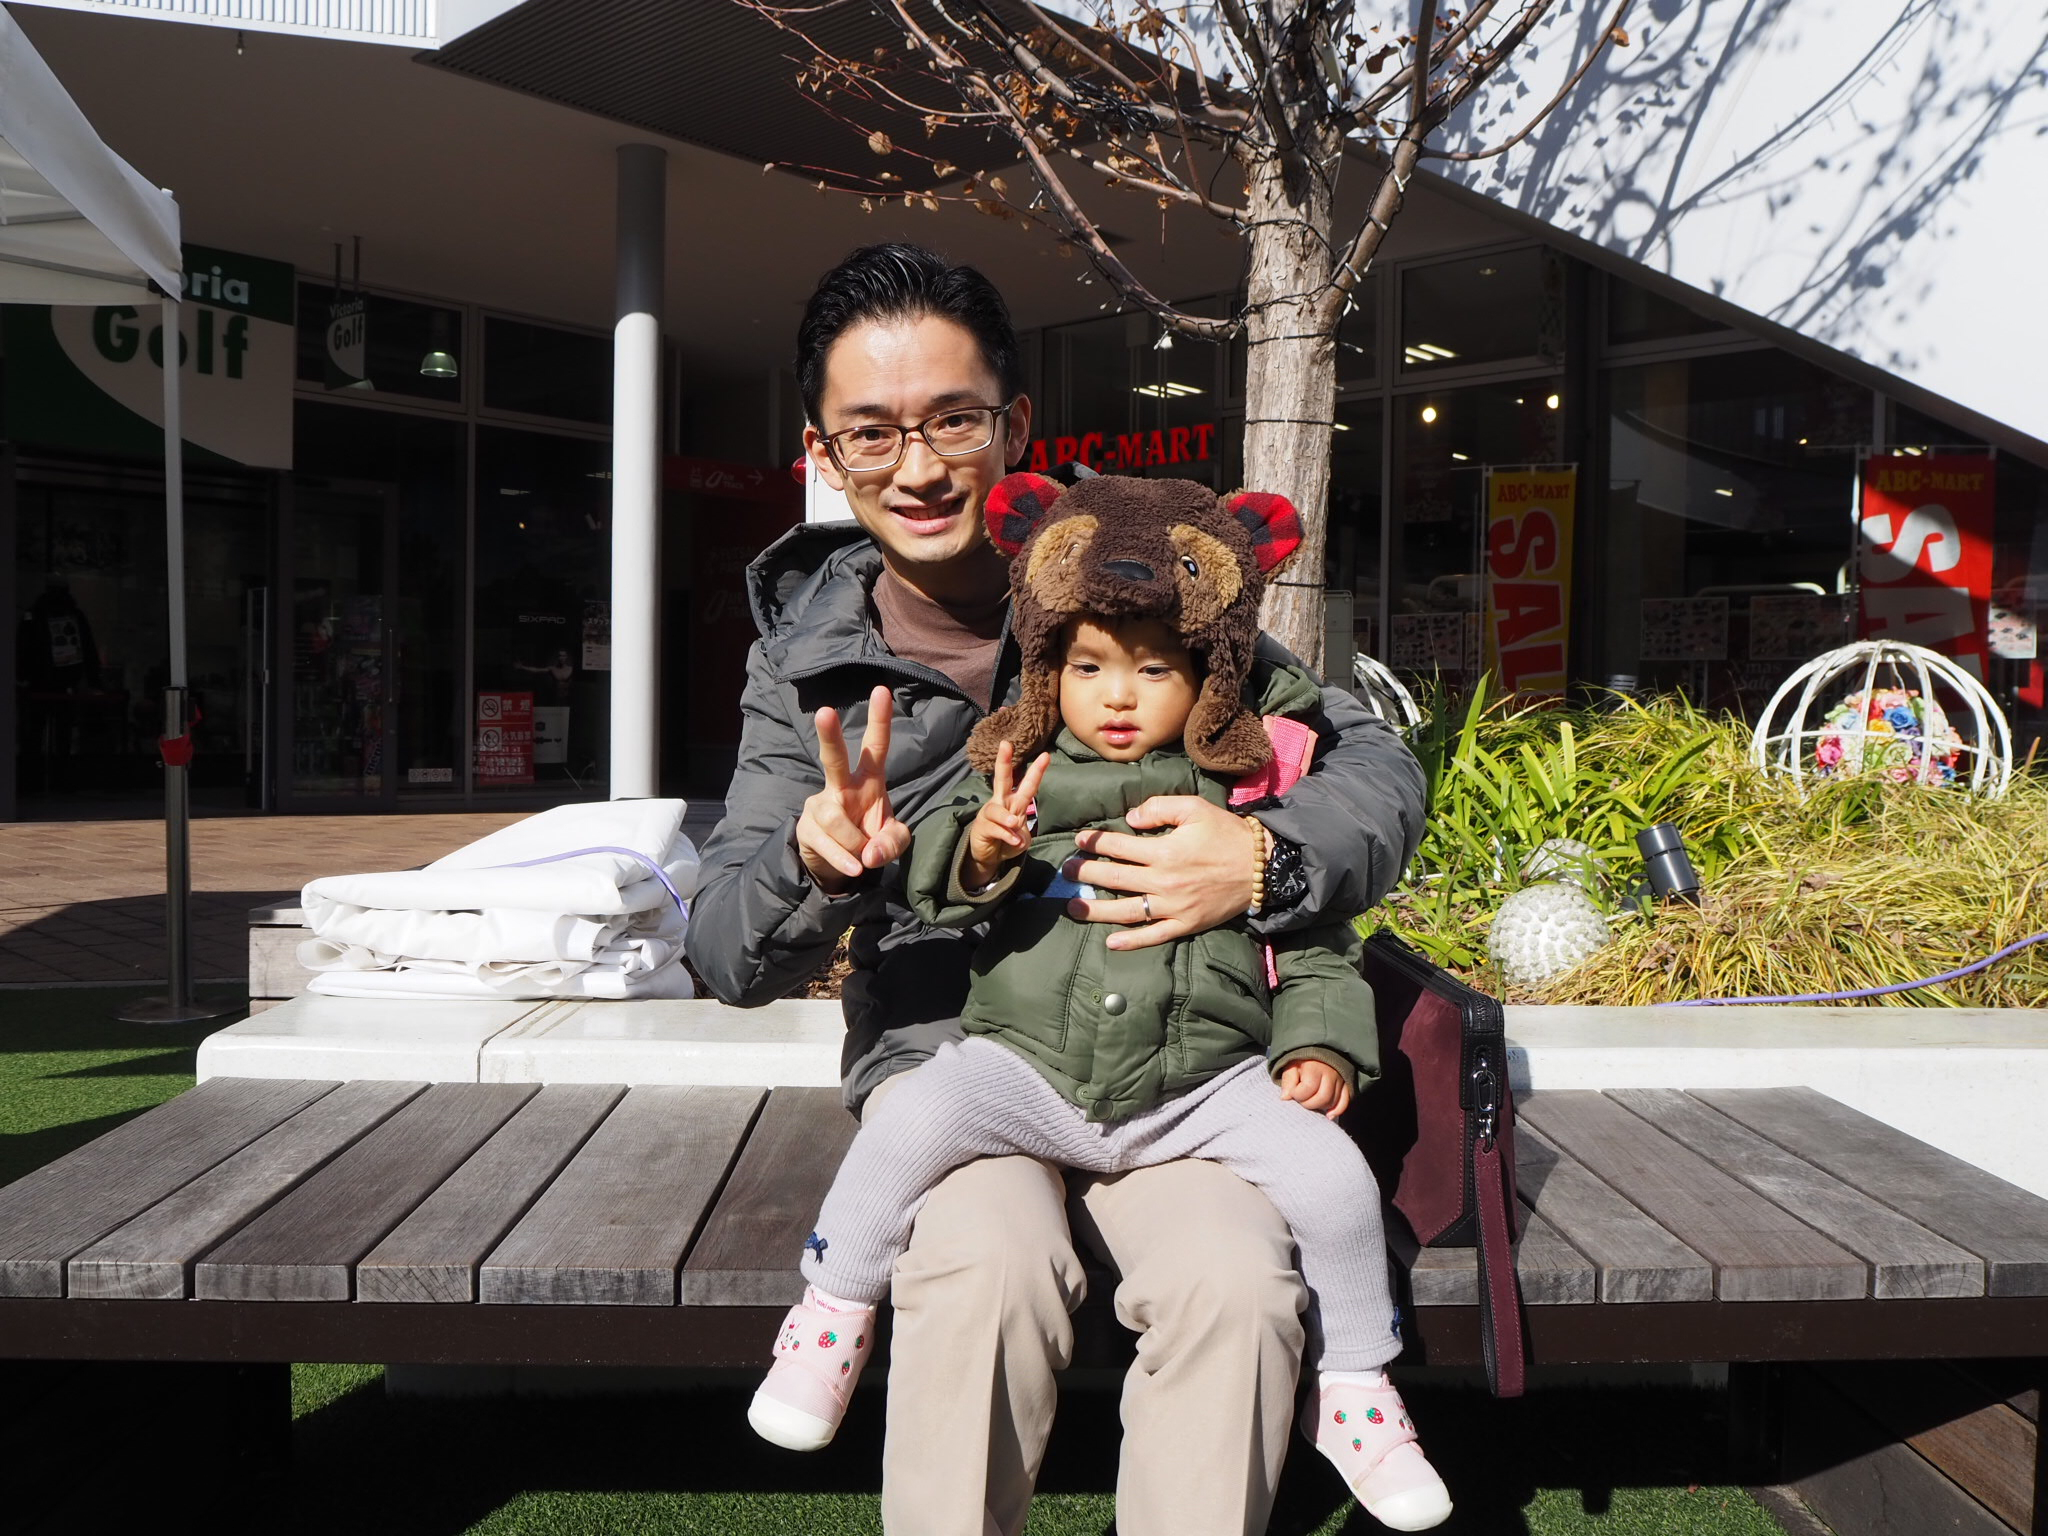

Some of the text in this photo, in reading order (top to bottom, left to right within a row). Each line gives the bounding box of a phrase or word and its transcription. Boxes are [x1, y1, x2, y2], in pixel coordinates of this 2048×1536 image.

[180, 265, 250, 305] ria
[329, 296, 364, 319] Victoria
[93, 305, 249, 379] Golf
[334, 315, 363, 351] Golf
[1029, 423, 1215, 473] ABC-MART
[1874, 469, 1985, 492] ABC-MART
[518, 615, 566, 625] SIXPAD
